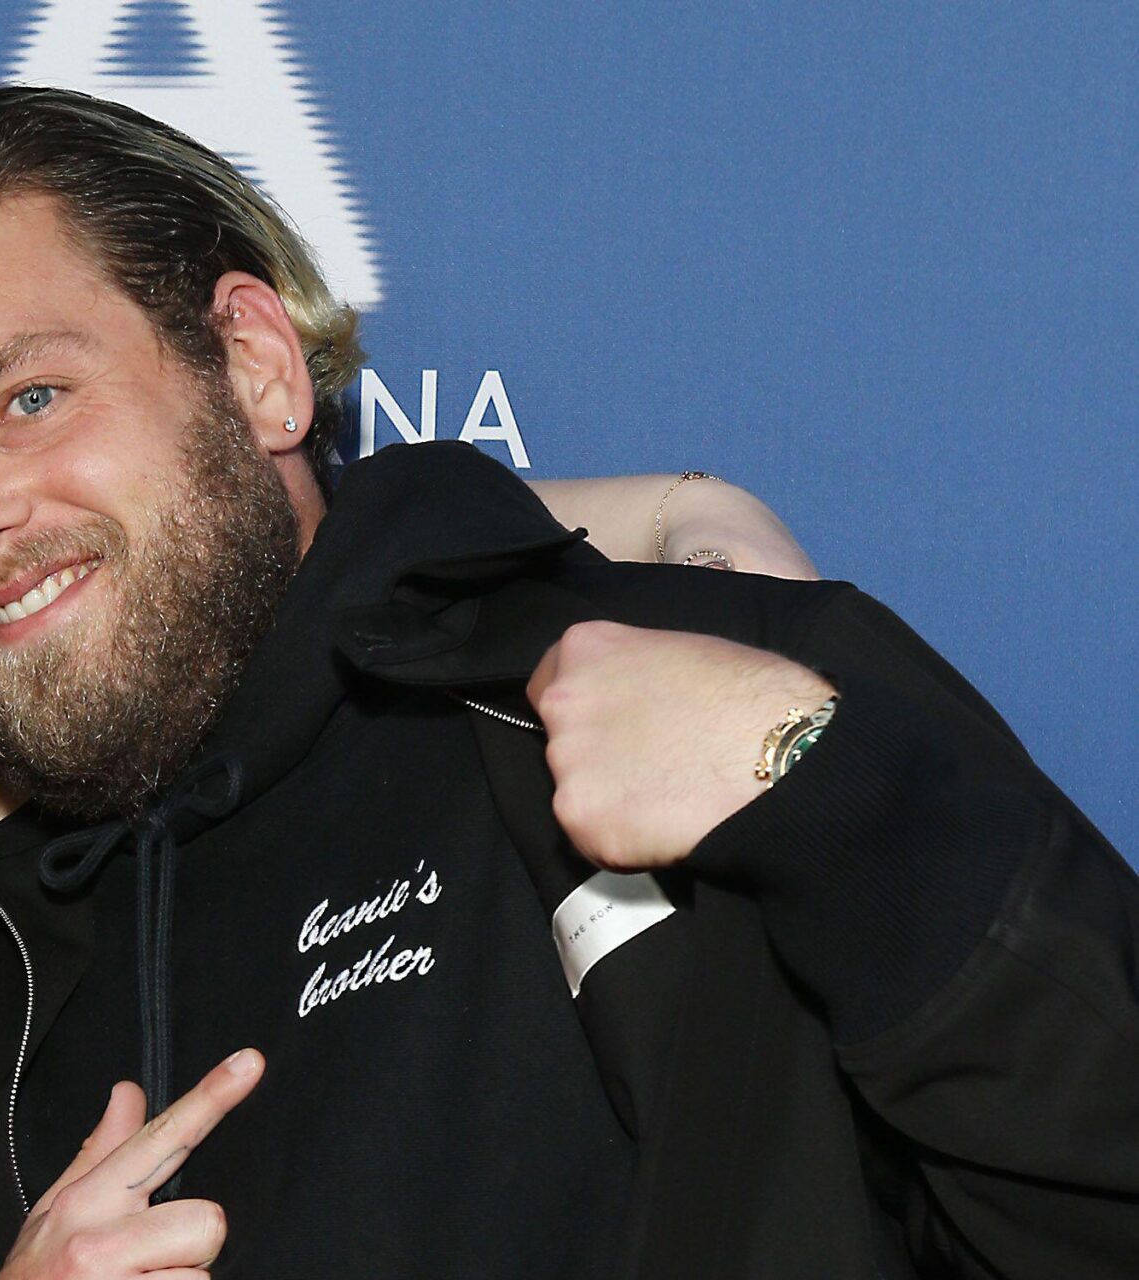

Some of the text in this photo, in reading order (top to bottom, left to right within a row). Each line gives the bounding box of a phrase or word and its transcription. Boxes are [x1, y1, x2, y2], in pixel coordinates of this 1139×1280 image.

[342, 369, 531, 469] NA
[298, 859, 442, 953] beanie's
[298, 935, 435, 1018] brother
